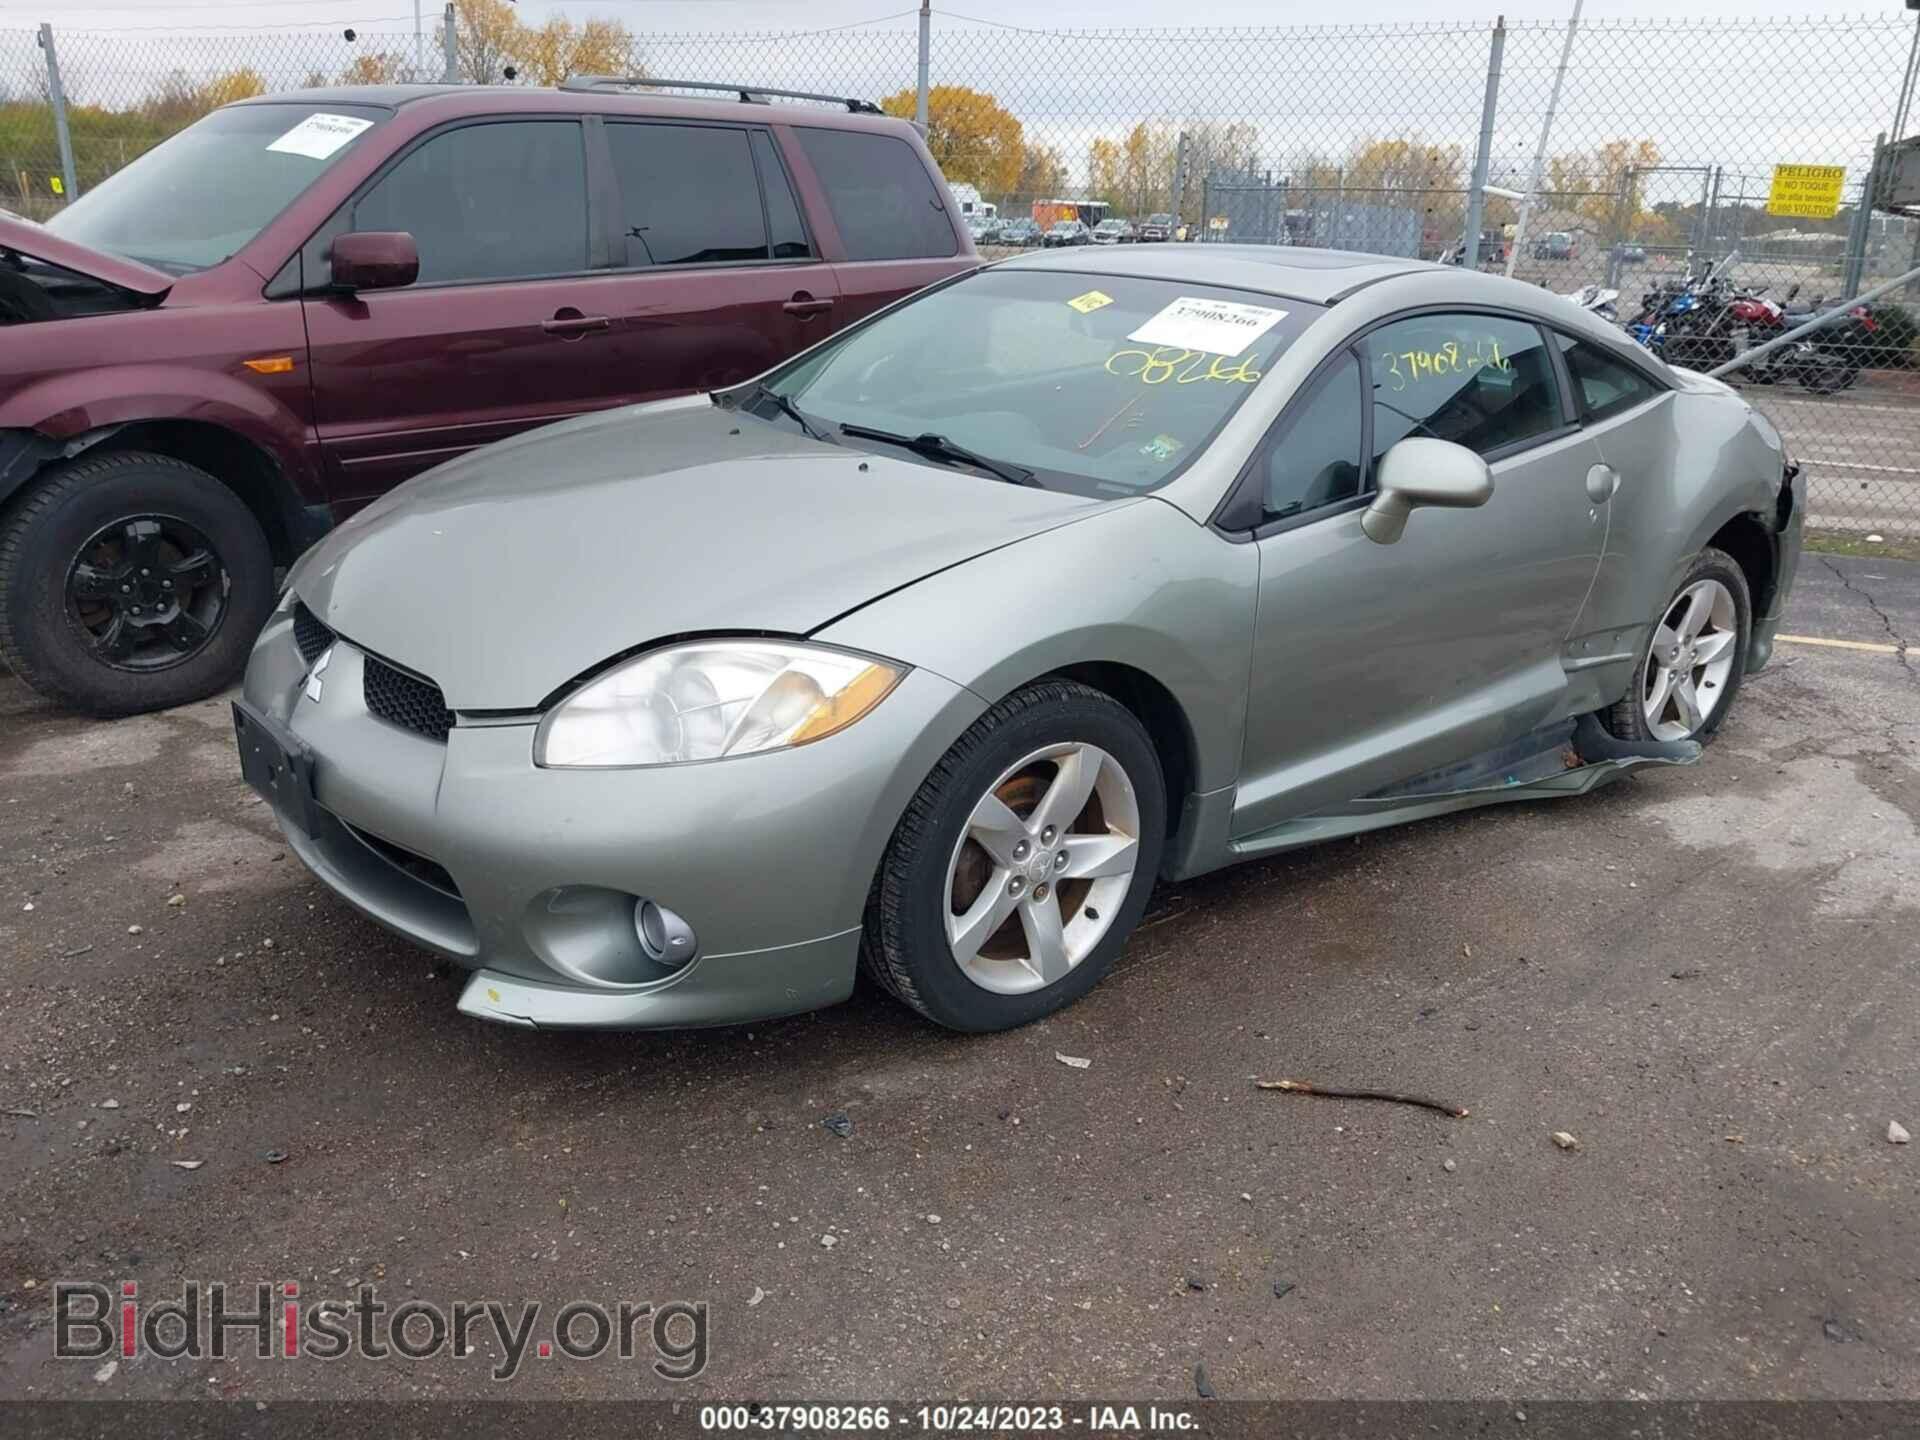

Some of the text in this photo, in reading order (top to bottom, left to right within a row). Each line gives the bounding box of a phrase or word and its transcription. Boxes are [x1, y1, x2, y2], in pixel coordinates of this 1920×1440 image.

[1777, 167, 1843, 178] PELIGRO
[1785, 181, 1829, 192] NO TOQUE
